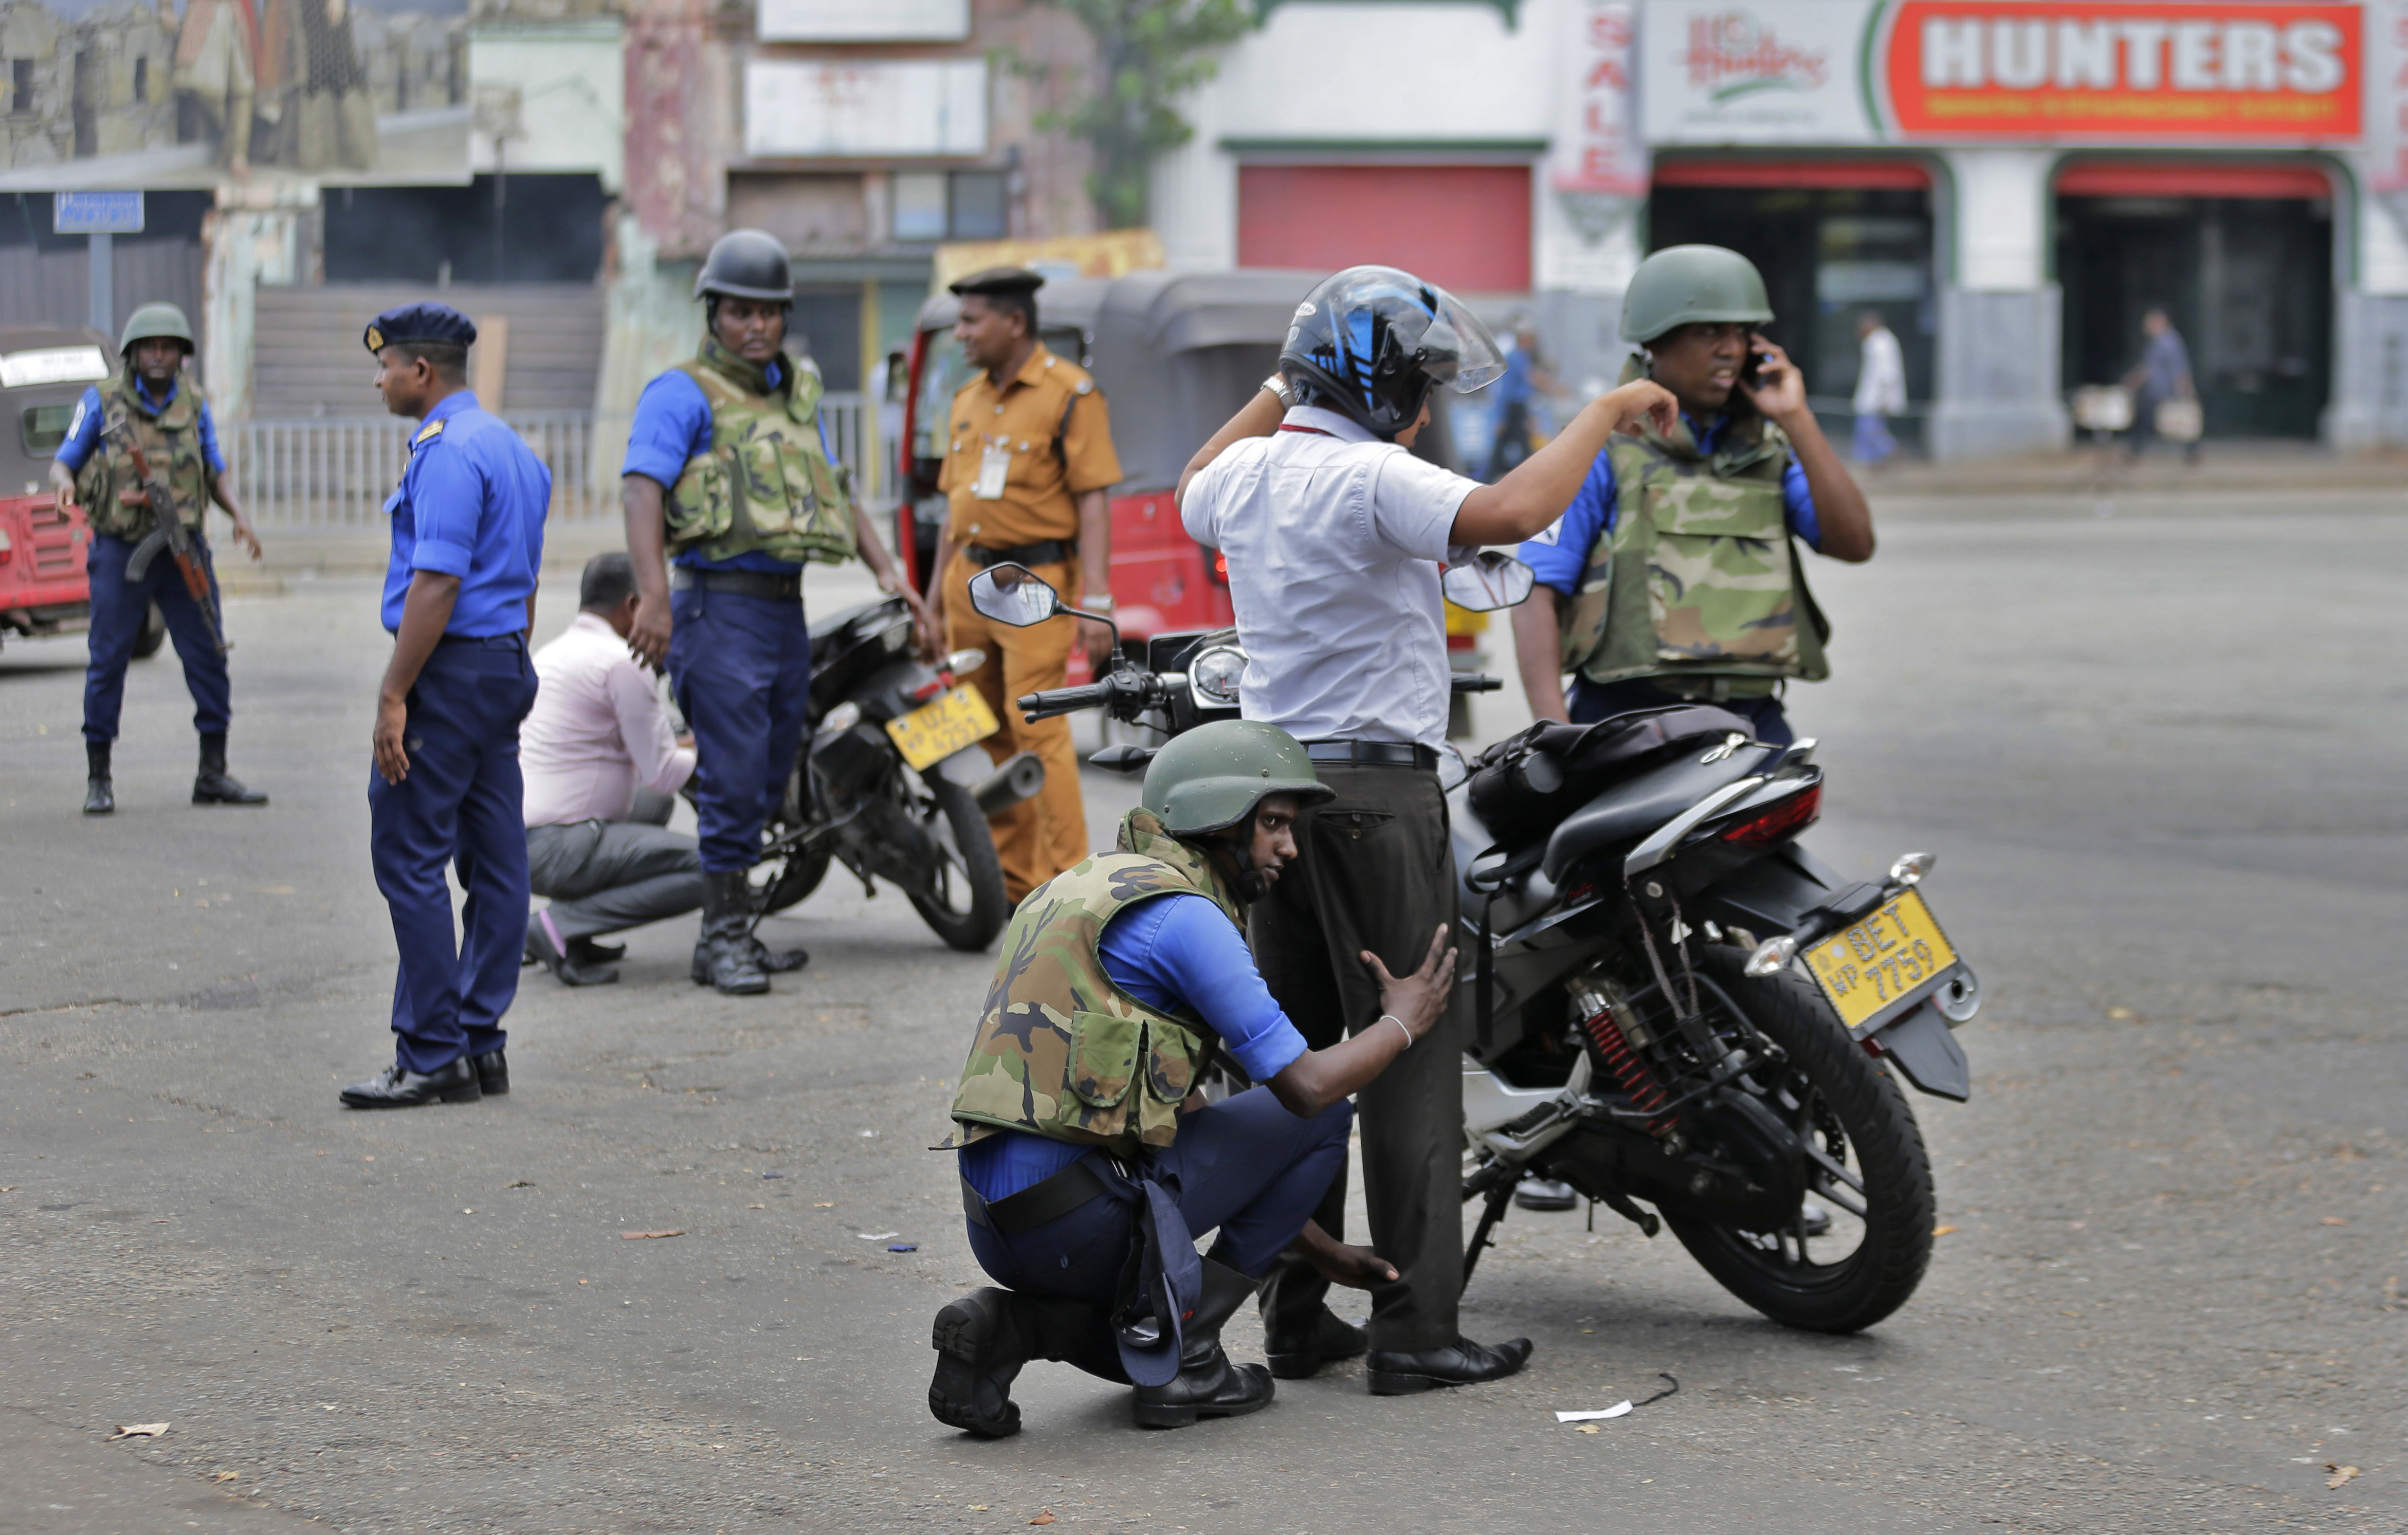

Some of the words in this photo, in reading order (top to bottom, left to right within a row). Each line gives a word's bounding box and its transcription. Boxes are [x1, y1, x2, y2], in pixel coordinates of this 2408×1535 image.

[1923, 17, 2346, 92] HUNTERS
[1584, 13, 1633, 181] SALE
[1848, 903, 1909, 962] BET
[1827, 963, 1858, 997] WP
[1866, 939, 1933, 1001] 7759
